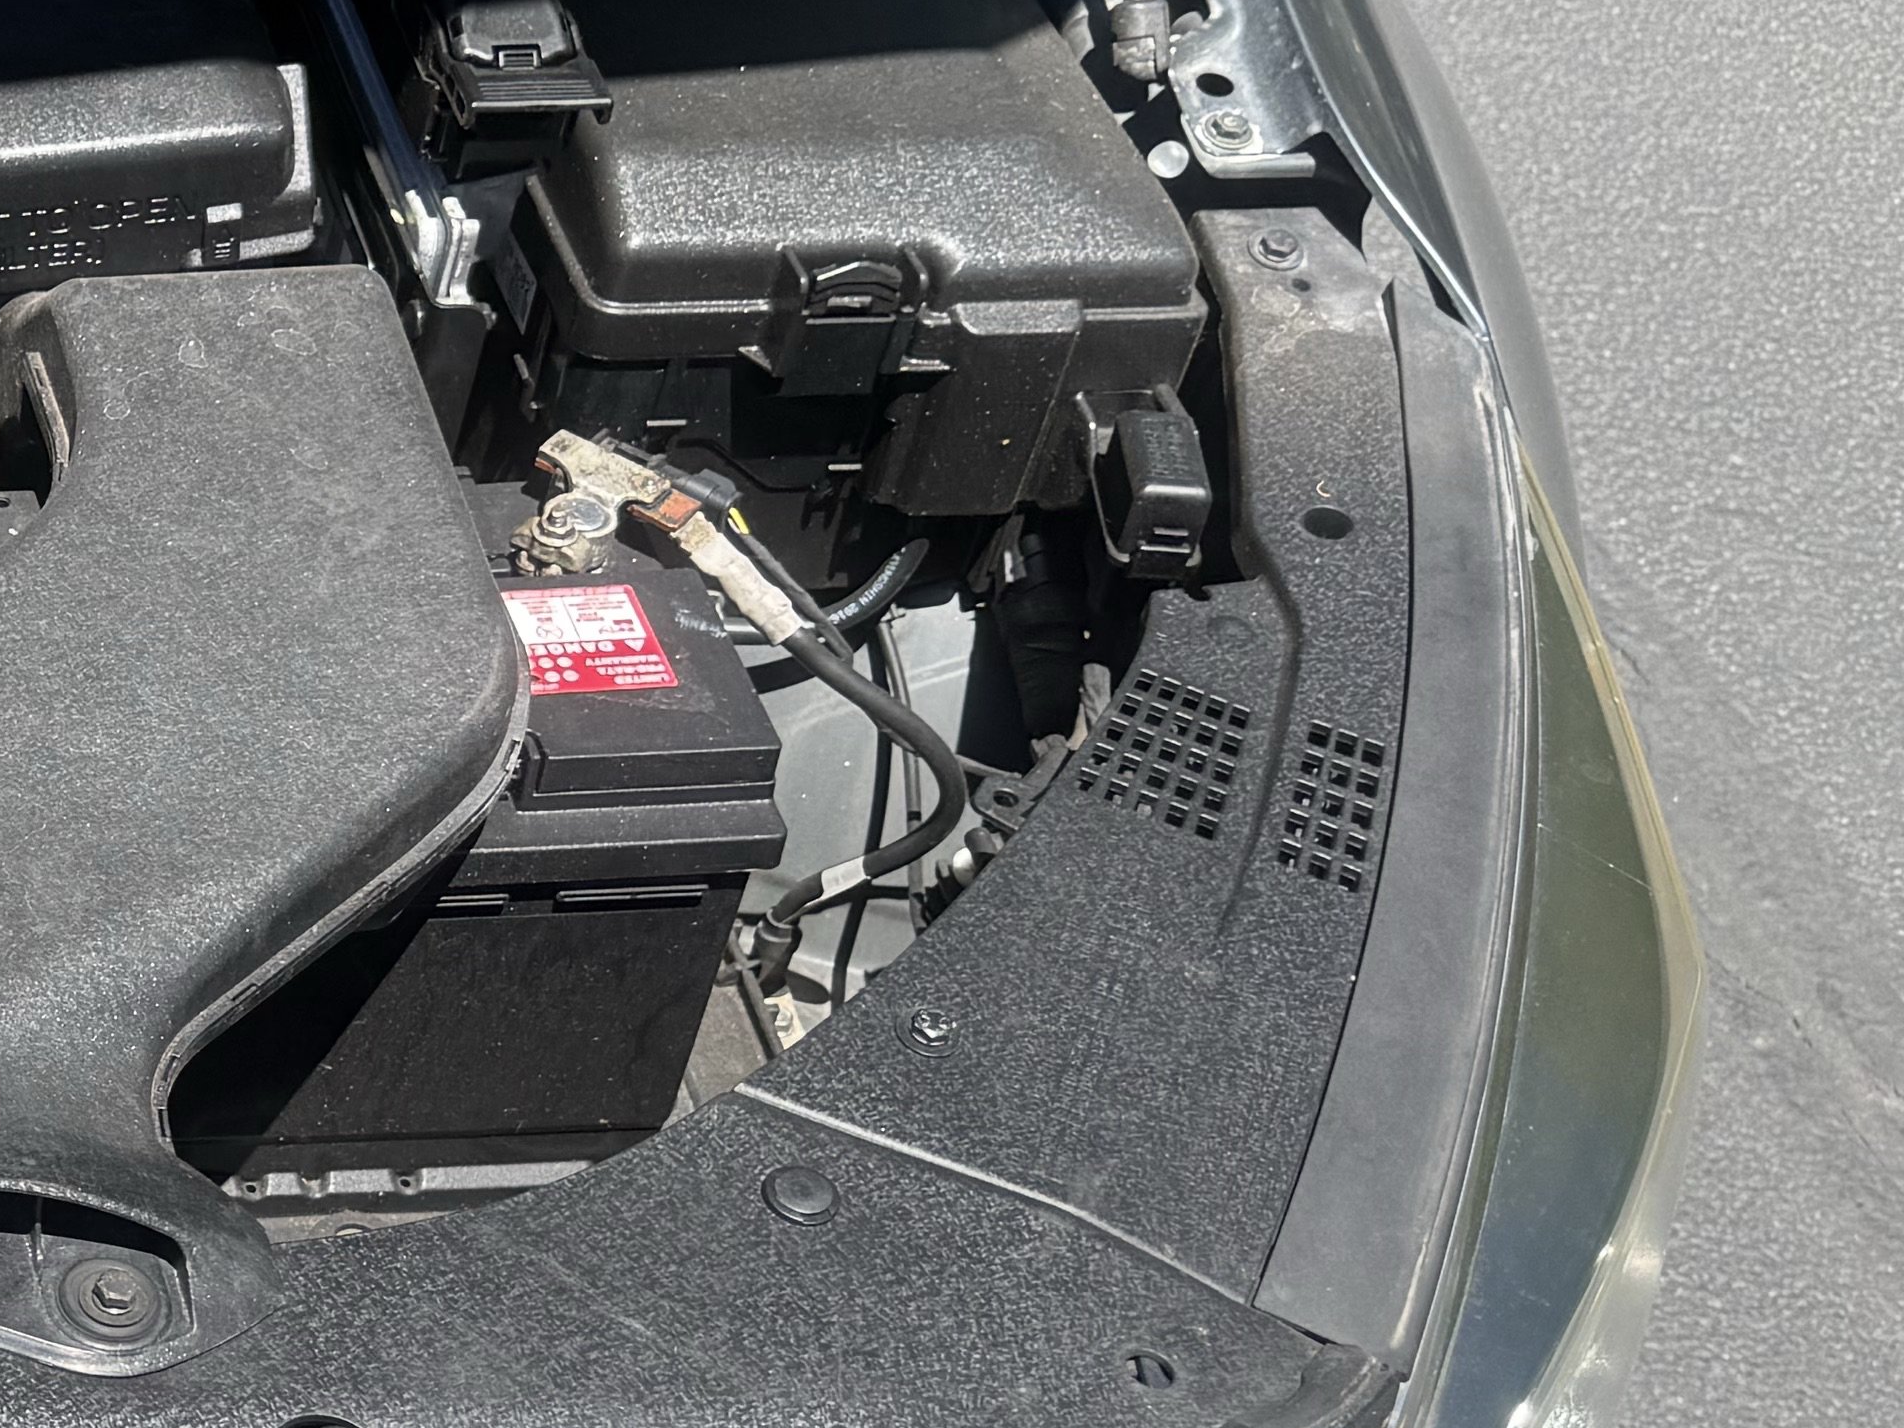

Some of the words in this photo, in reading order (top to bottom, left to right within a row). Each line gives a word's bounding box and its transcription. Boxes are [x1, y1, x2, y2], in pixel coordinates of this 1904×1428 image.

[21, 206, 73, 238] TO
[88, 196, 197, 232] OPEN
[527, 640, 616, 657] DANGE
